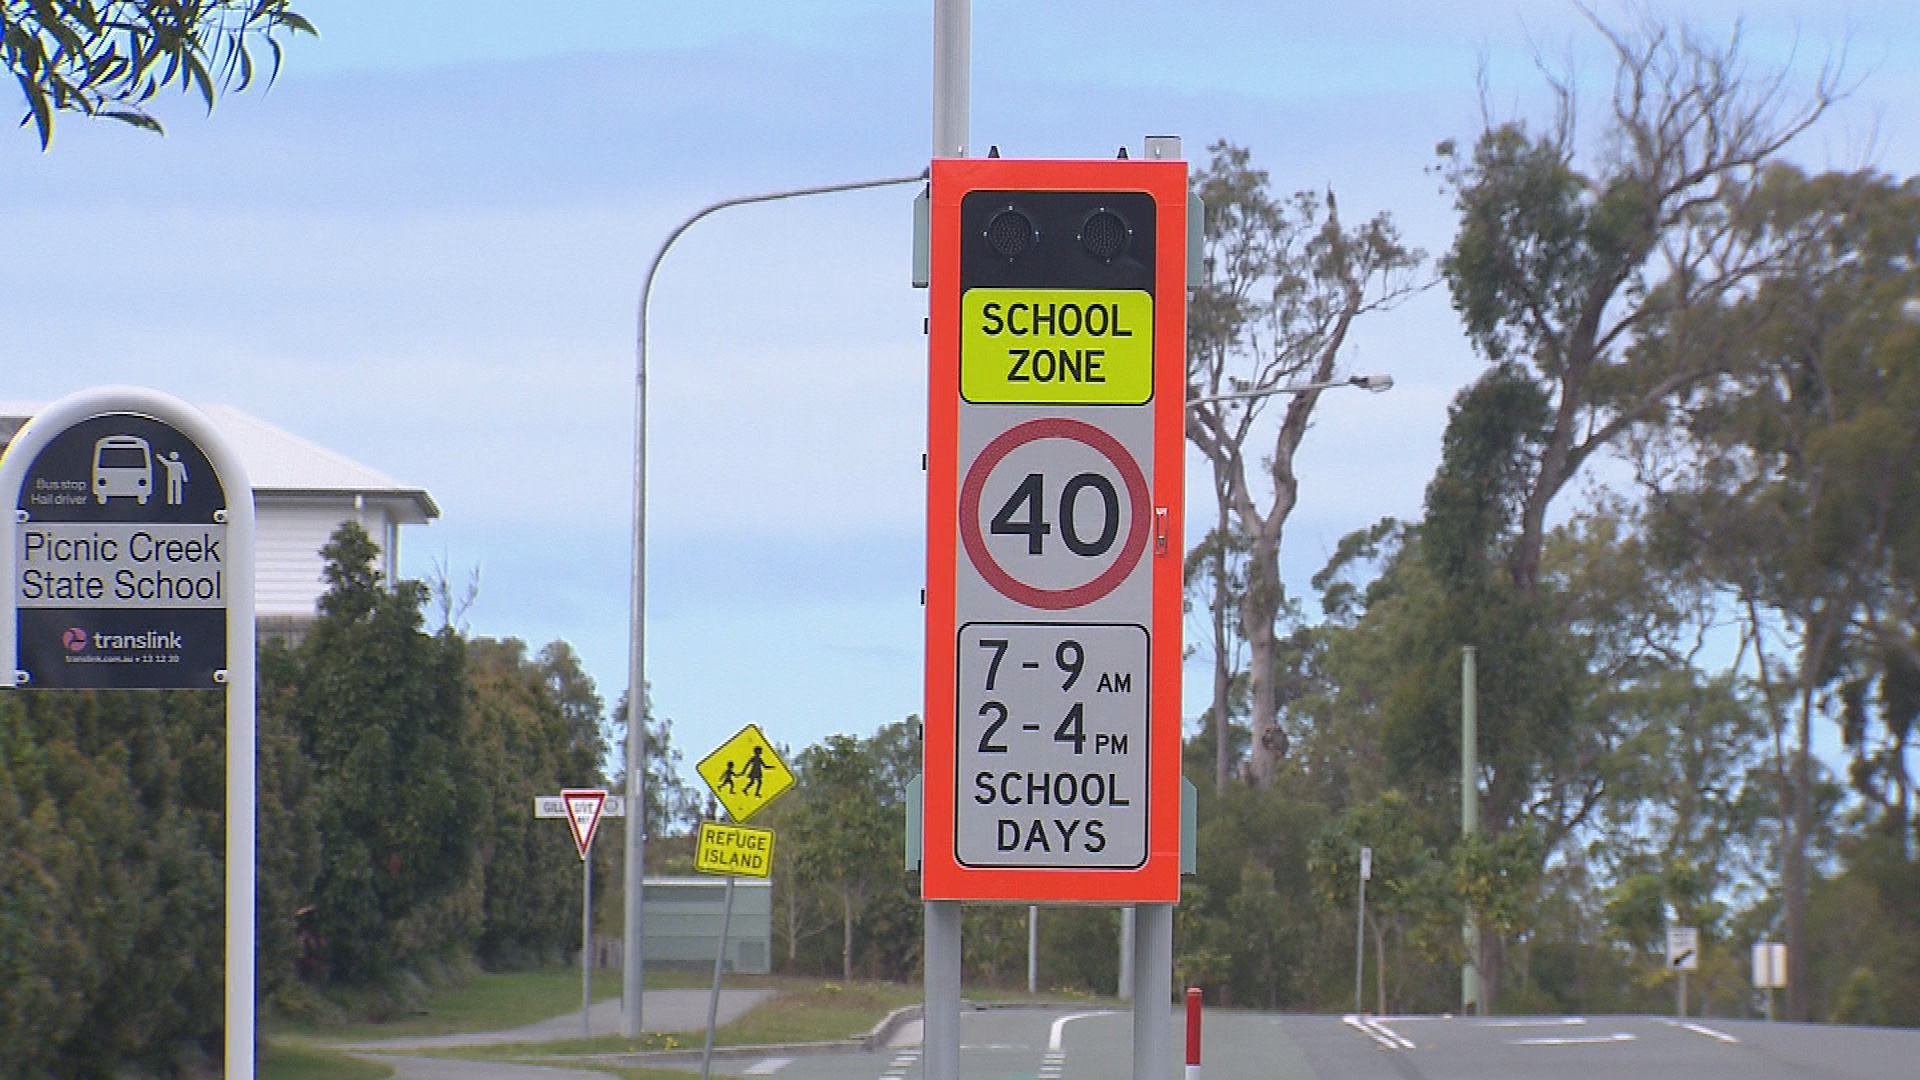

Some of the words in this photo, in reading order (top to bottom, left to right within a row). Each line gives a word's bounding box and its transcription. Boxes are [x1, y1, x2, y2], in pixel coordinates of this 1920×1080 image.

[982, 303, 1133, 337] SCHOOL
[1007, 349, 1106, 383] ZONE
[36, 478, 60, 490] Bus
[60, 480, 87, 492] stop
[54, 493, 88, 505] driver
[990, 473, 1120, 557] 40
[24, 531, 118, 562] Picnic
[129, 531, 221, 562] Creek
[21, 569, 104, 599] State
[114, 569, 222, 599] School
[92, 630, 182, 649] translink
[979, 639, 1009, 691] 7
[1055, 639, 1085, 692] 9
[1096, 672, 1132, 693] AM
[978, 701, 1009, 753] 2
[1053, 702, 1086, 755] 4
[1094, 734, 1128, 755] PM
[974, 772, 1130, 807] SCHOOL
[705, 829, 767, 851] REFUGE
[997, 819, 1106, 853] DAYS
[704, 849, 763, 869] ISLAND
